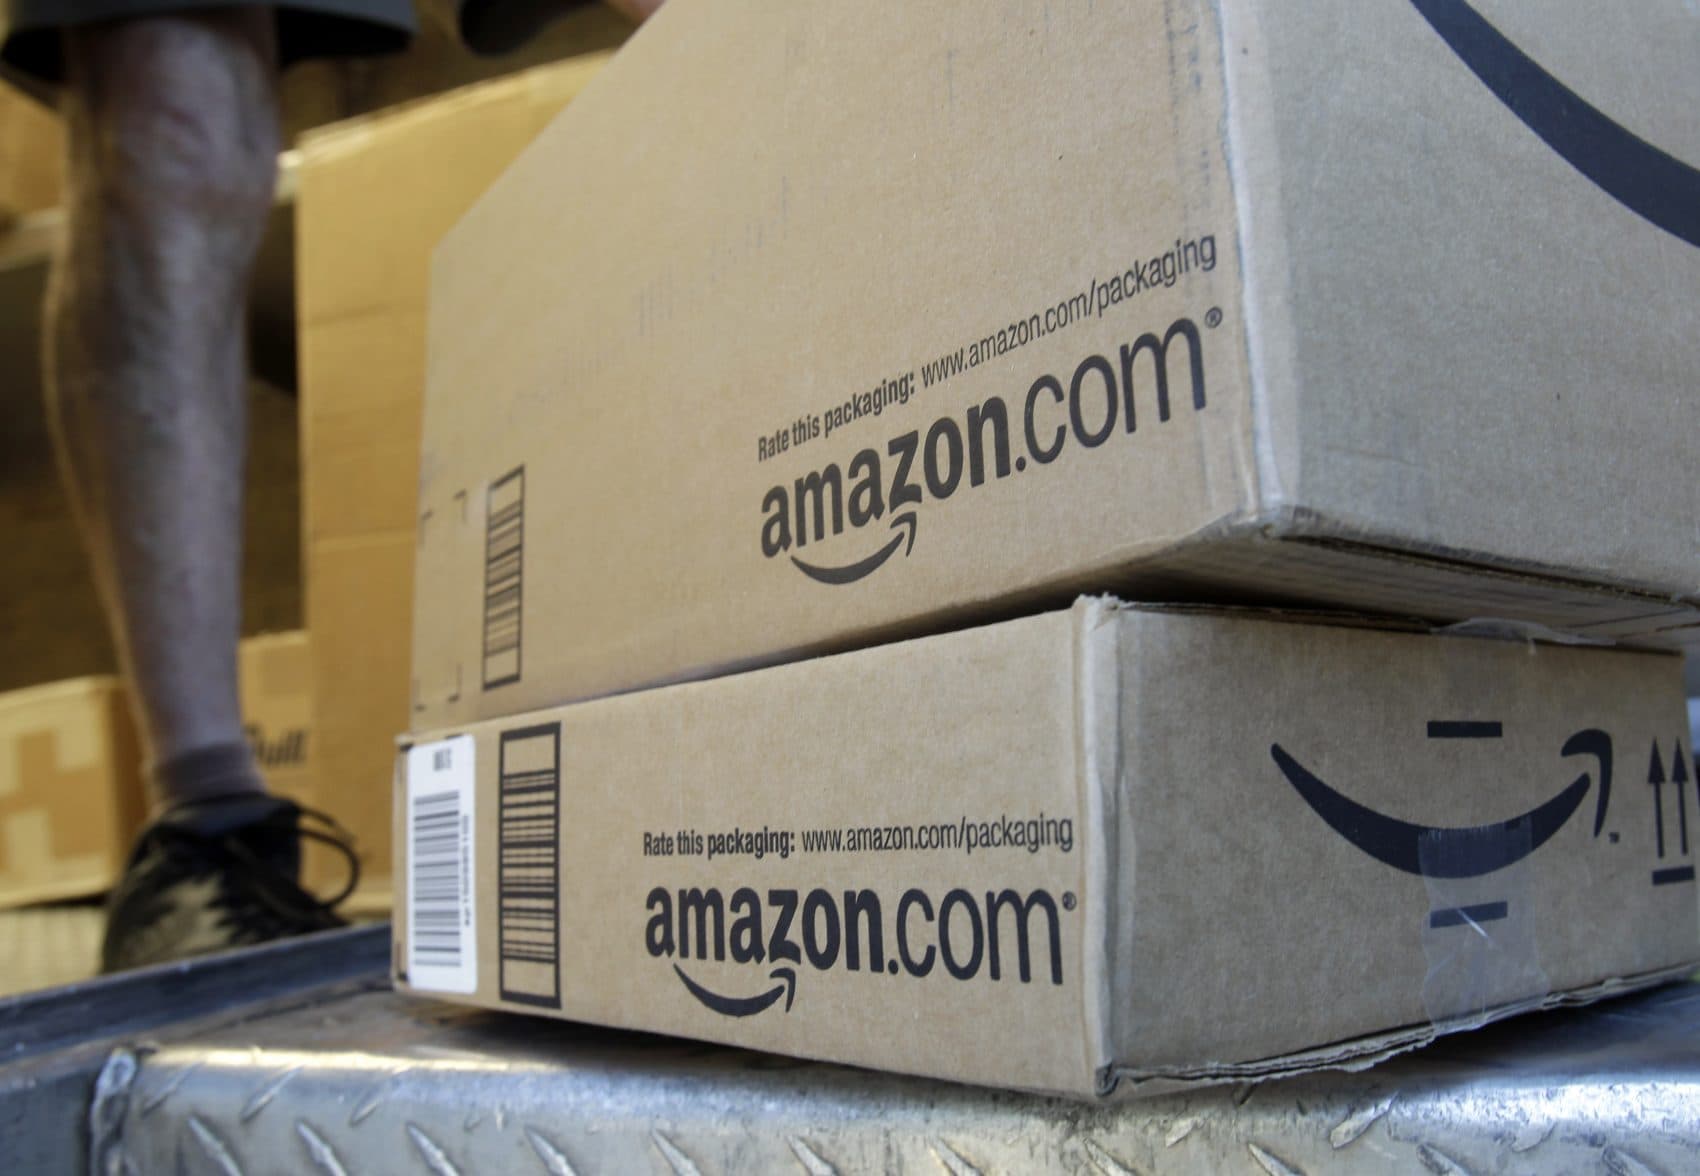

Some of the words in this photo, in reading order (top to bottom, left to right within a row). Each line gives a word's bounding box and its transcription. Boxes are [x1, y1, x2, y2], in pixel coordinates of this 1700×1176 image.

[758, 428, 790, 462] Rate
[791, 406, 821, 447] this
[823, 370, 916, 439] packaging:
[921, 235, 1217, 389] www.amazon.com/packaging
[643, 831, 675, 857] Rate
[676, 828, 704, 856] this
[706, 826, 796, 861] packaging:
[801, 812, 1074, 855] www.amazon.com/packaging
